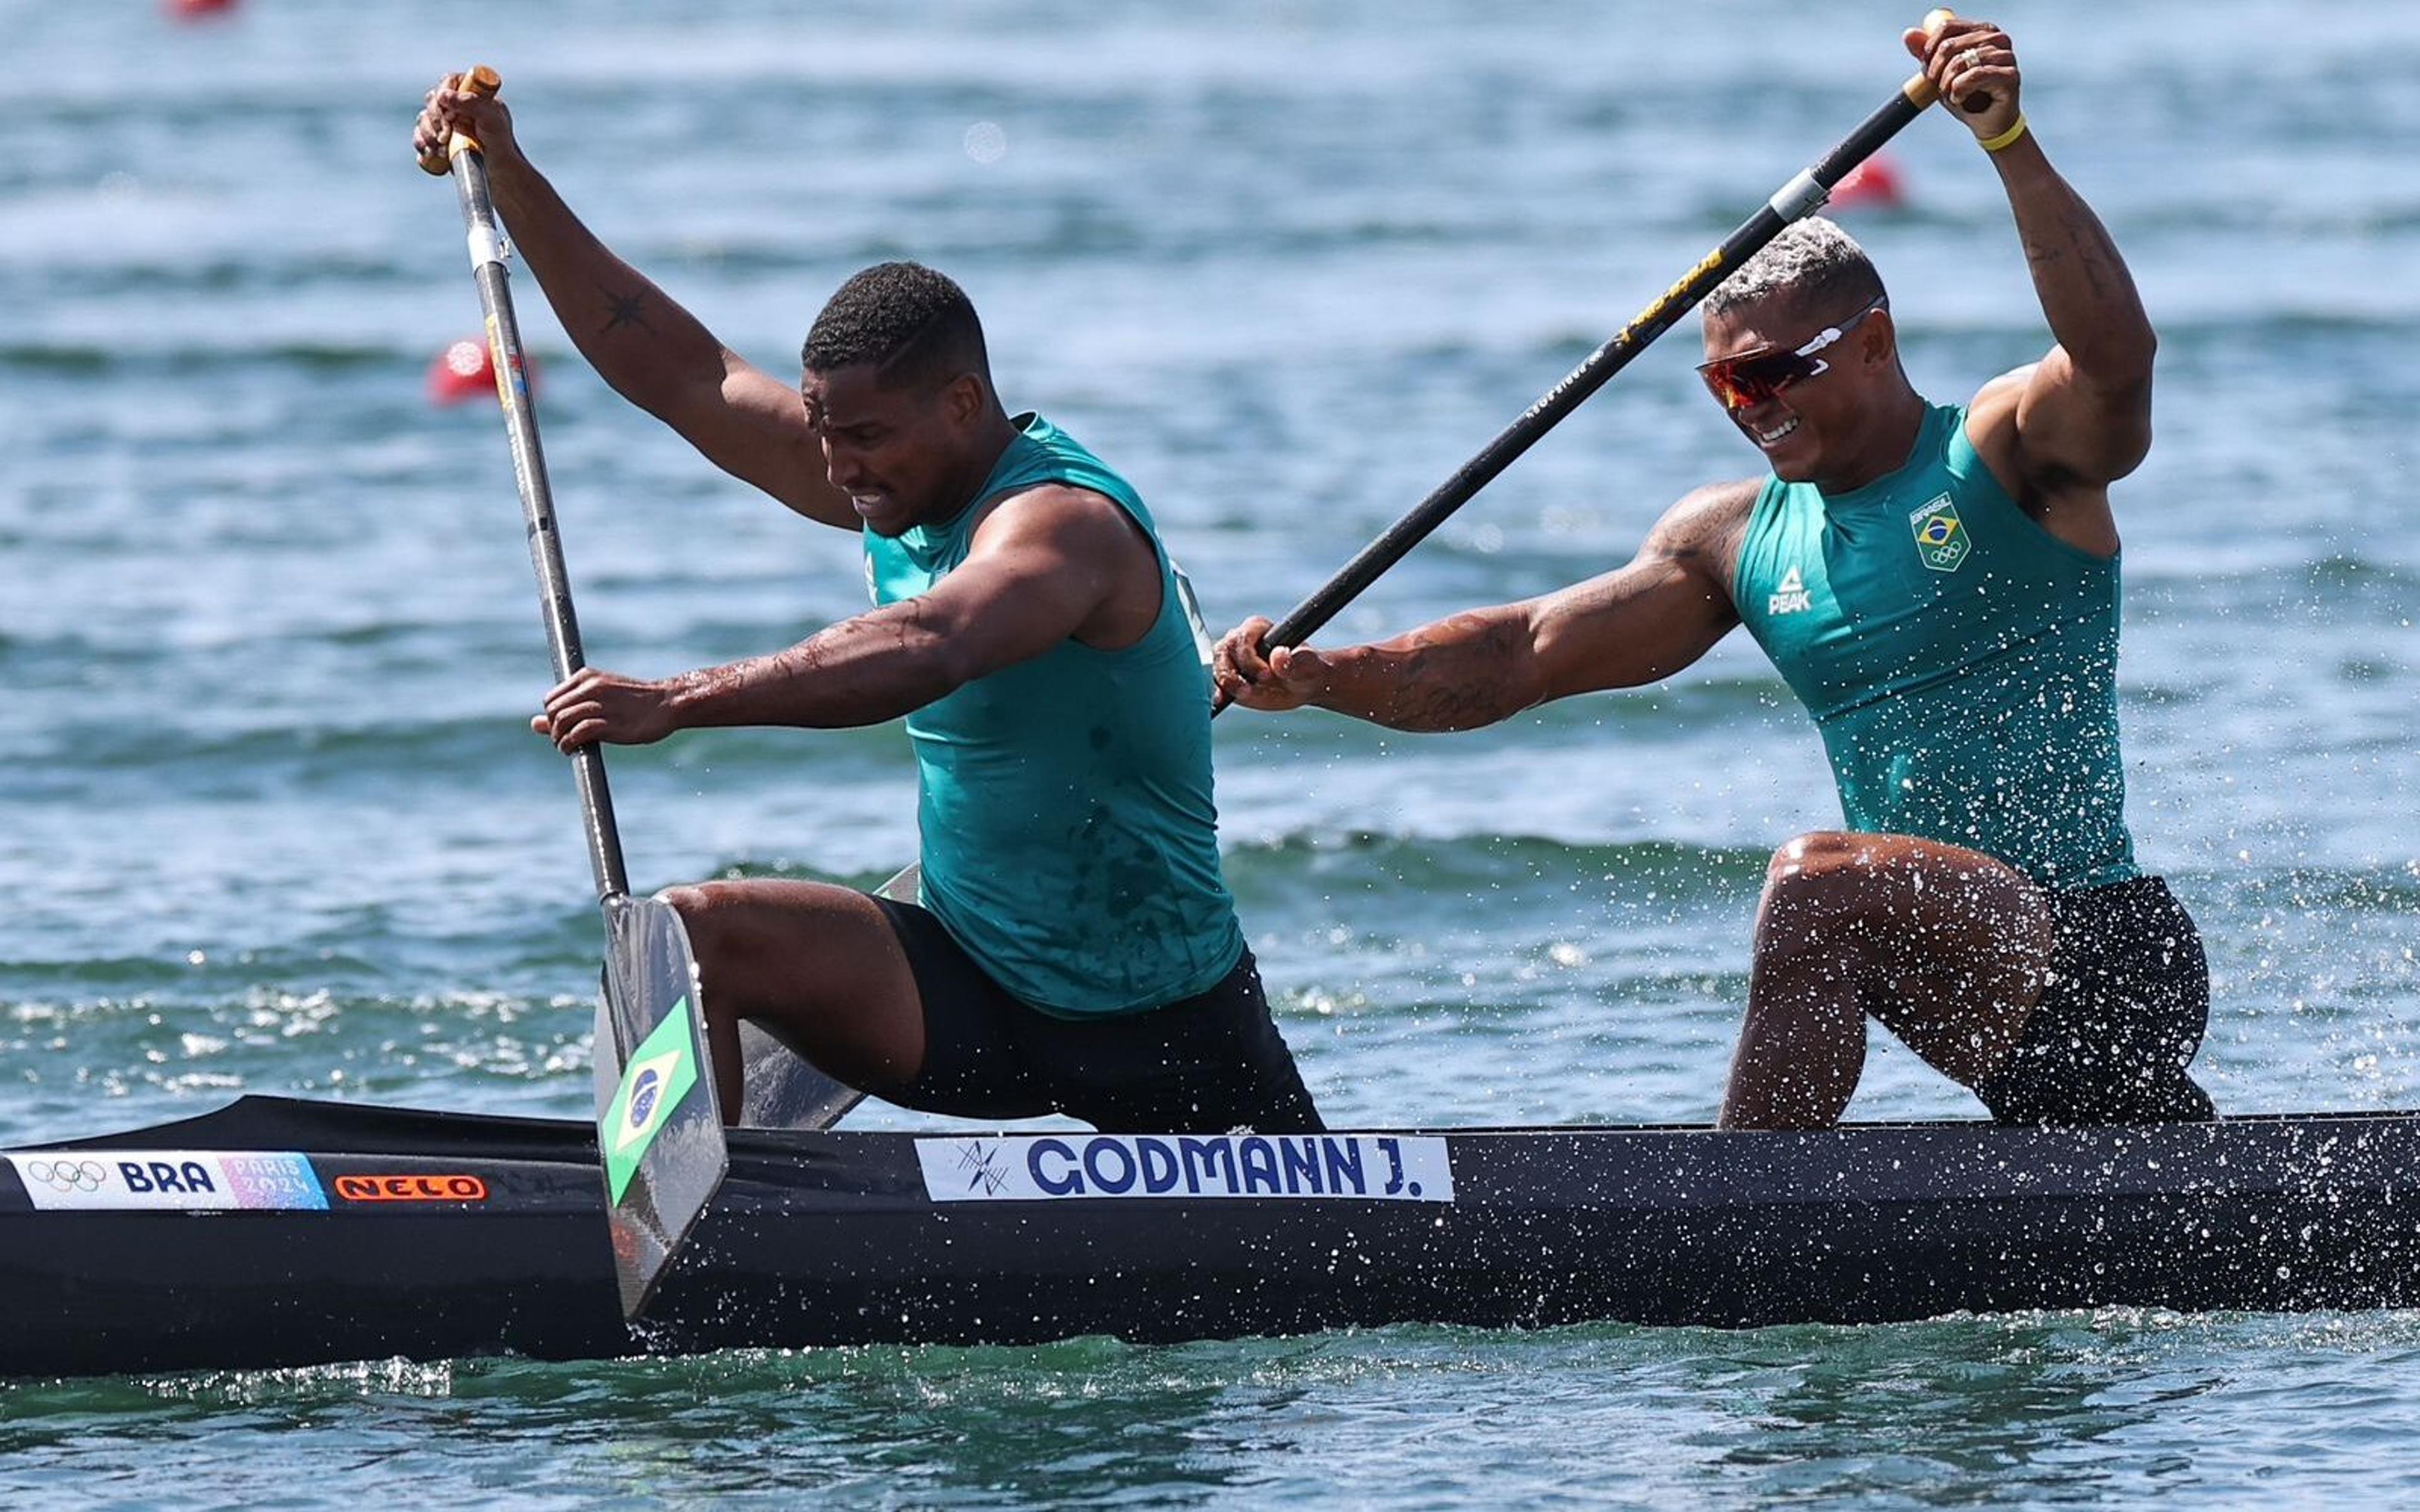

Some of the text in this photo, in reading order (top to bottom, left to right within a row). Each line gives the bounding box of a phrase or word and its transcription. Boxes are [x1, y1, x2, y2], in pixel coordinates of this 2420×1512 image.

[1768, 590, 1812, 616] PEAK
[118, 1162, 216, 1193] BRA
[232, 1160, 300, 1176] PARIS
[1027, 1137, 1423, 1198] GODMANN J.
[241, 1177, 309, 1197] 2024
[342, 1178, 479, 1196] NELO
